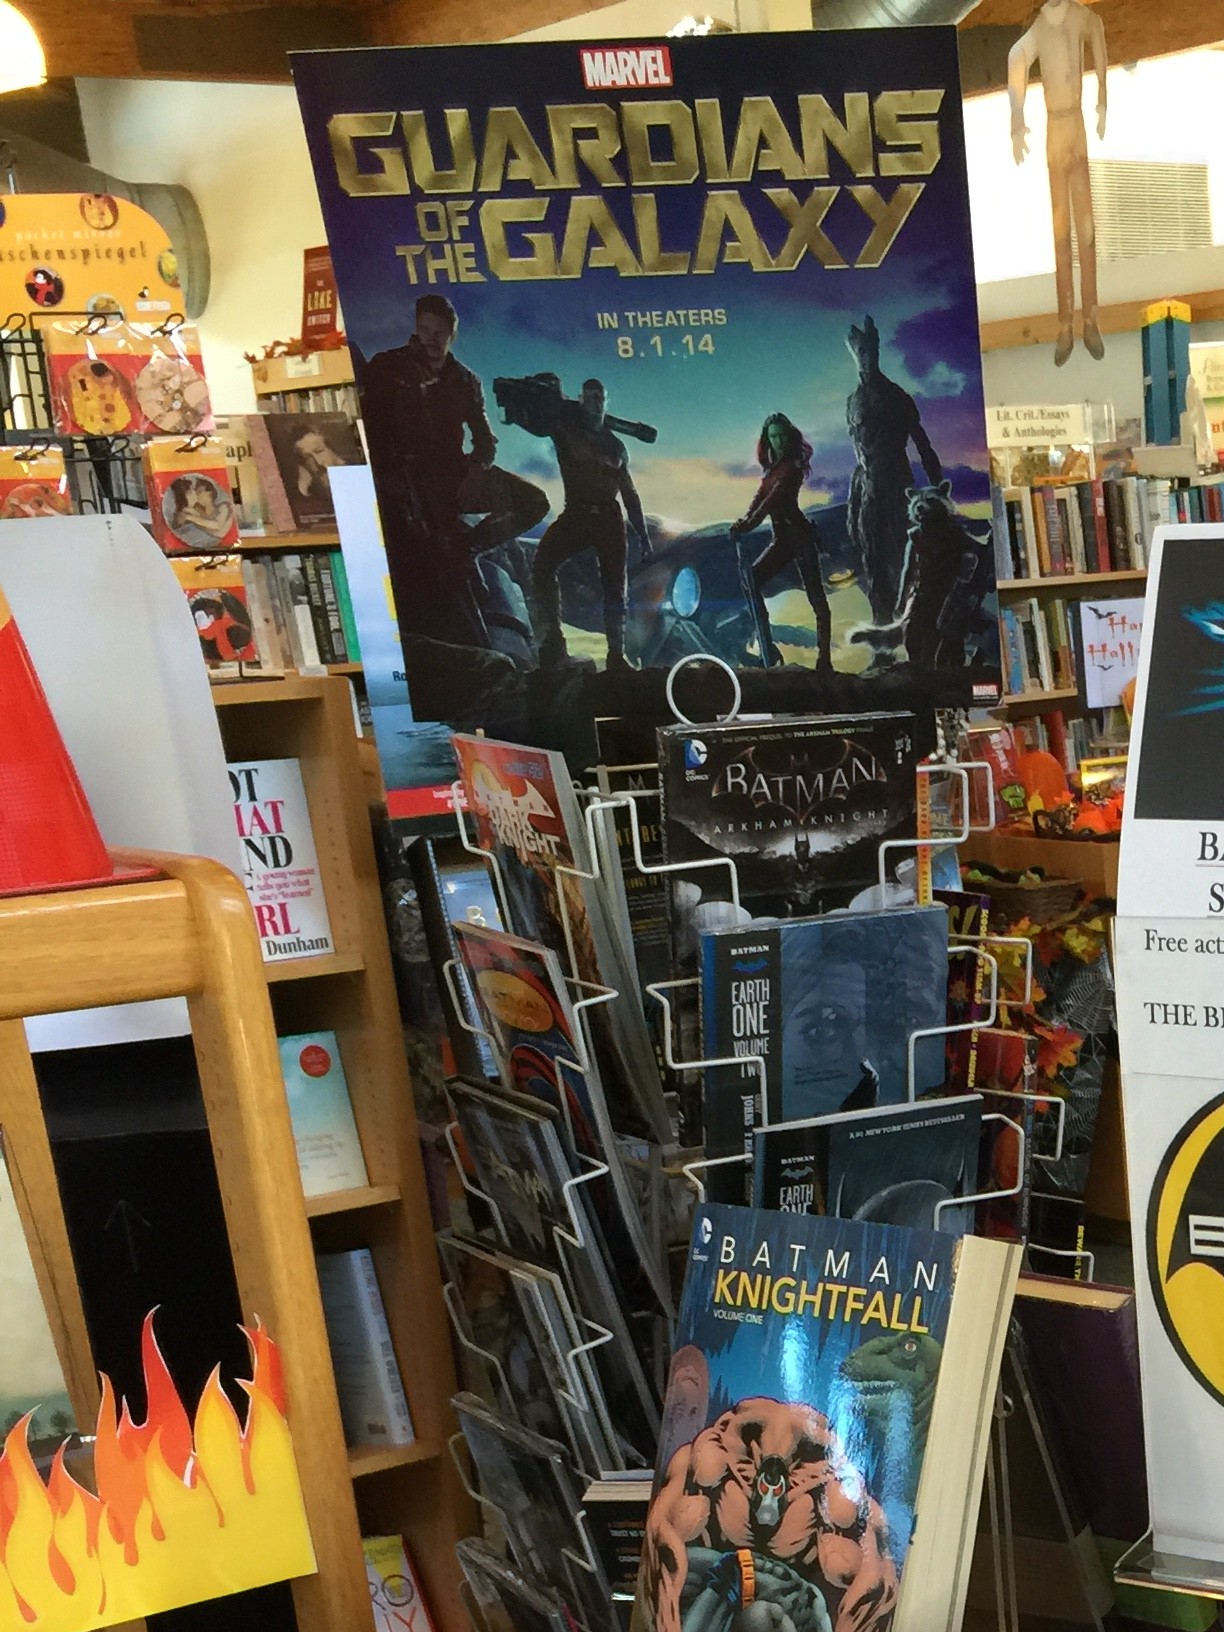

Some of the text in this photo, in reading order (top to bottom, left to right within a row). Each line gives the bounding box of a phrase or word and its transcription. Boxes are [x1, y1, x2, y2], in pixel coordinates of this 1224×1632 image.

[581, 46, 671, 88] MARVEL
[325, 88, 946, 197] GUARDIANS
[395, 181, 927, 285] THE GALAXY
[415, 200, 471, 242] OF
[597, 307, 728, 330] IN THEATERS
[1002, 425, 1068, 440] & Anthologies
[971, 684, 999, 697] MARVEL
[725, 755, 877, 806] BATMAN
[713, 808, 889, 835] ARKHAM KNIGHT
[497, 827, 561, 860] KNIGHT
[264, 935, 330, 958] Dunham
[730, 944, 770, 956] BATMAN
[1143, 929, 1189, 953] Free
[731, 977, 771, 1005] EARTH
[732, 1003, 770, 1038] ONE
[1143, 1002, 1198, 1028] THE
[732, 1037, 770, 1058] VOLUME
[781, 1154, 816, 1165] BATMAN
[780, 1183, 814, 1207] EARTH
[719, 1235, 939, 1292] BATMAN
[713, 1268, 930, 1335] KNIGHTFALL
[713, 1308, 764, 1325] VOLUME ONE
